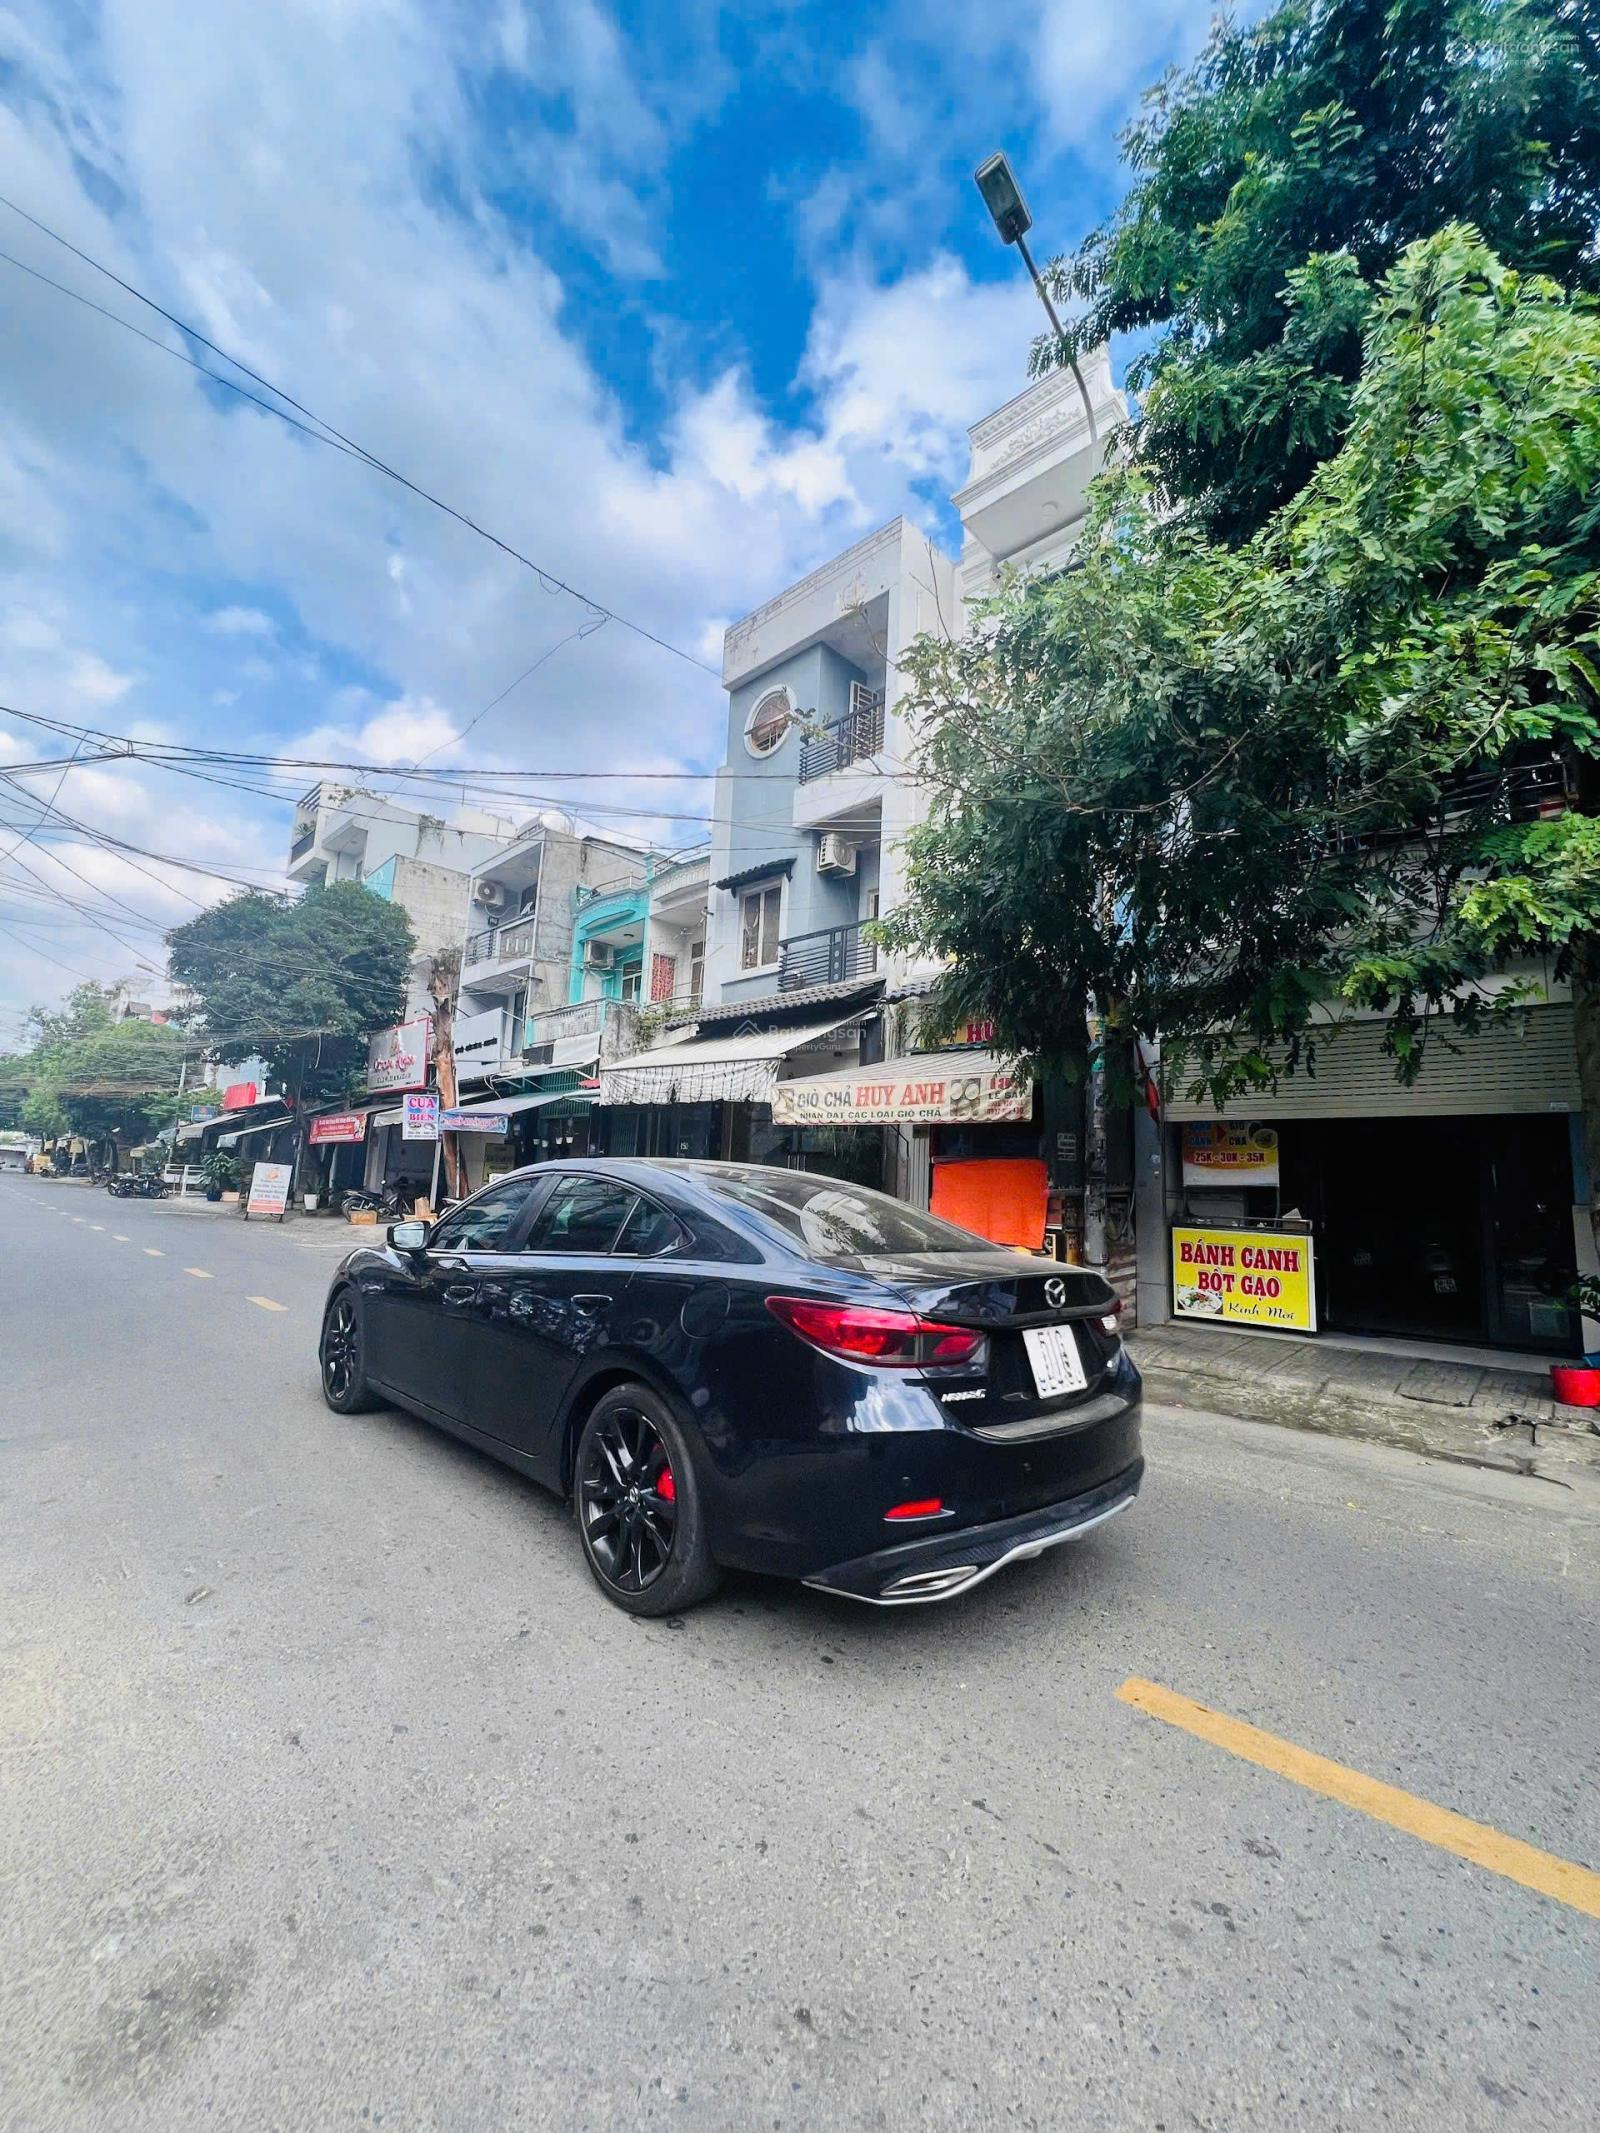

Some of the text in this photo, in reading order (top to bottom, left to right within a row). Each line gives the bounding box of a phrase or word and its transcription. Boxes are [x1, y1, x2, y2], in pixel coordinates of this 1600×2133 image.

[409, 1097, 435, 1109] CUA
[797, 1082, 947, 1108] GIÒ CHẢ HUY ANH
[1194, 1152, 1212, 1162] 25K
[1246, 1152, 1265, 1163] 35K
[1180, 1239, 1299, 1272] BÁNH CANH
[1240, 1275, 1281, 1301] GẠO
